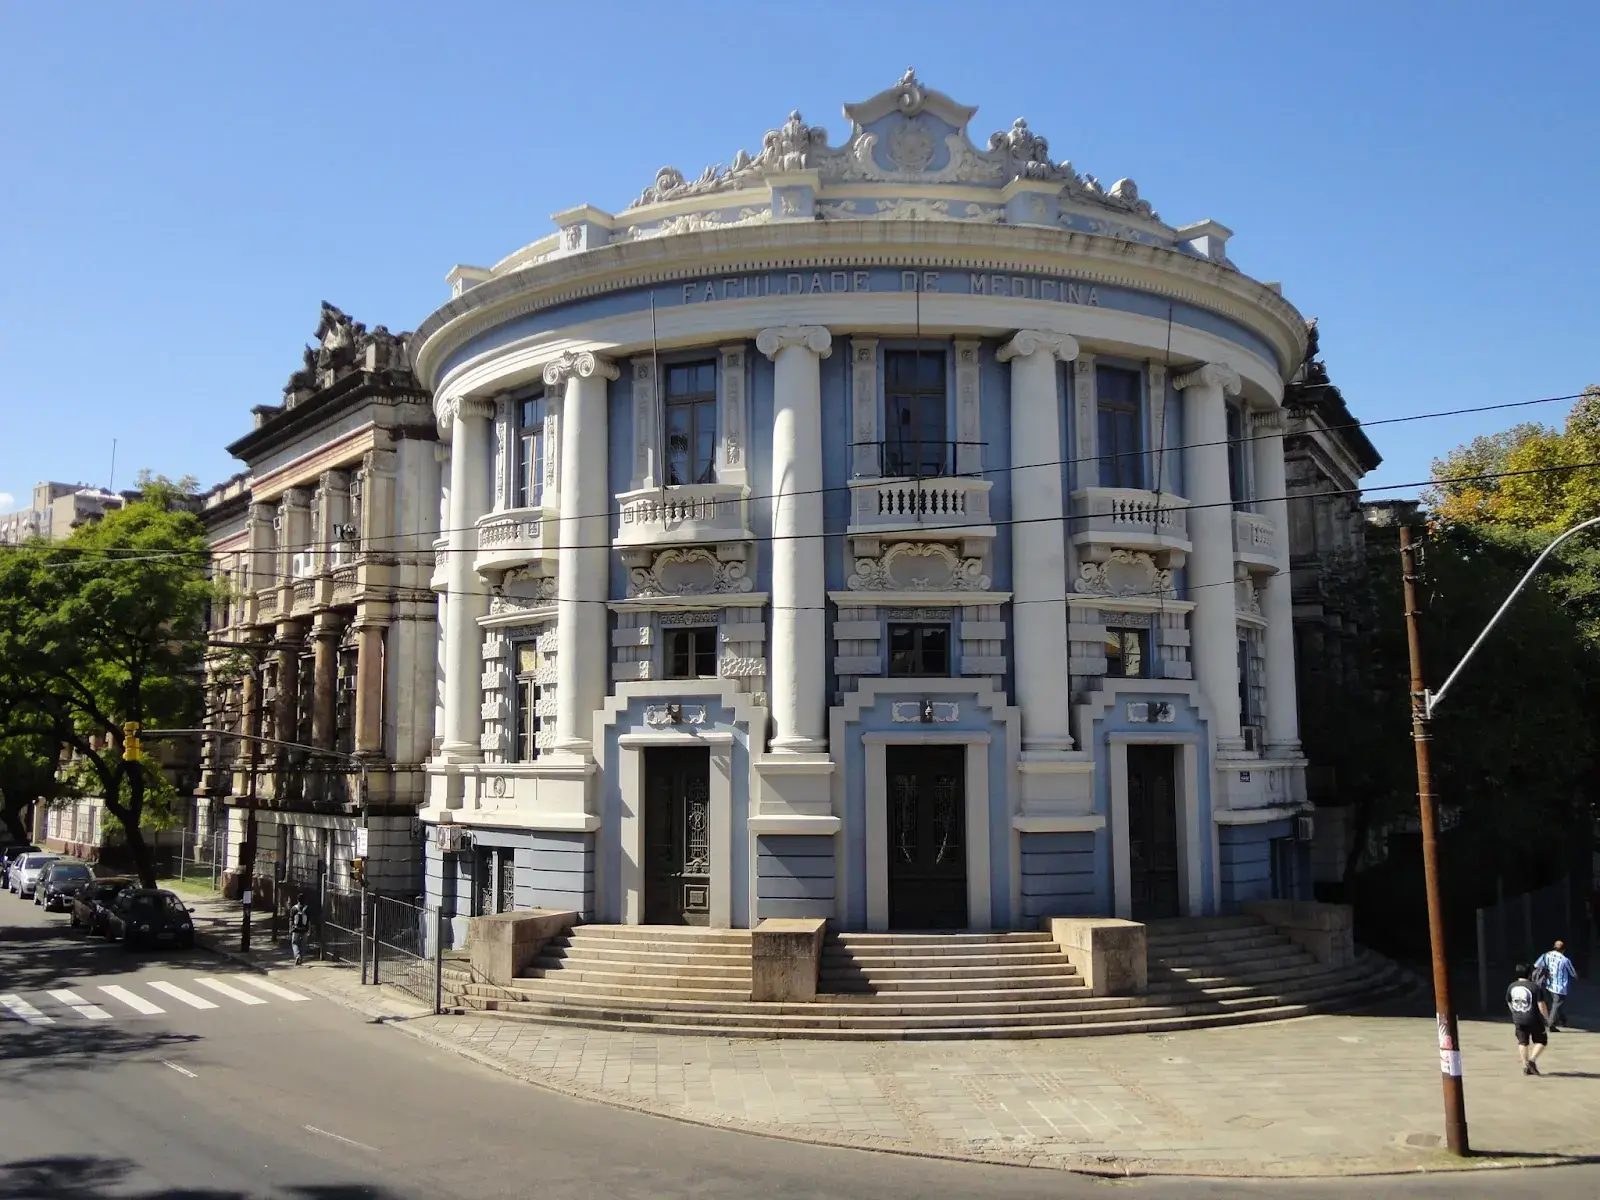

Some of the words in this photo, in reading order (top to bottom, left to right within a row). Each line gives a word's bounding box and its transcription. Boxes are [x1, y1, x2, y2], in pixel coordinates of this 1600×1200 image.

[682, 271, 870, 304] FACULDADE
[901, 270, 940, 293] DE
[970, 272, 1100, 307] MEDICINA
